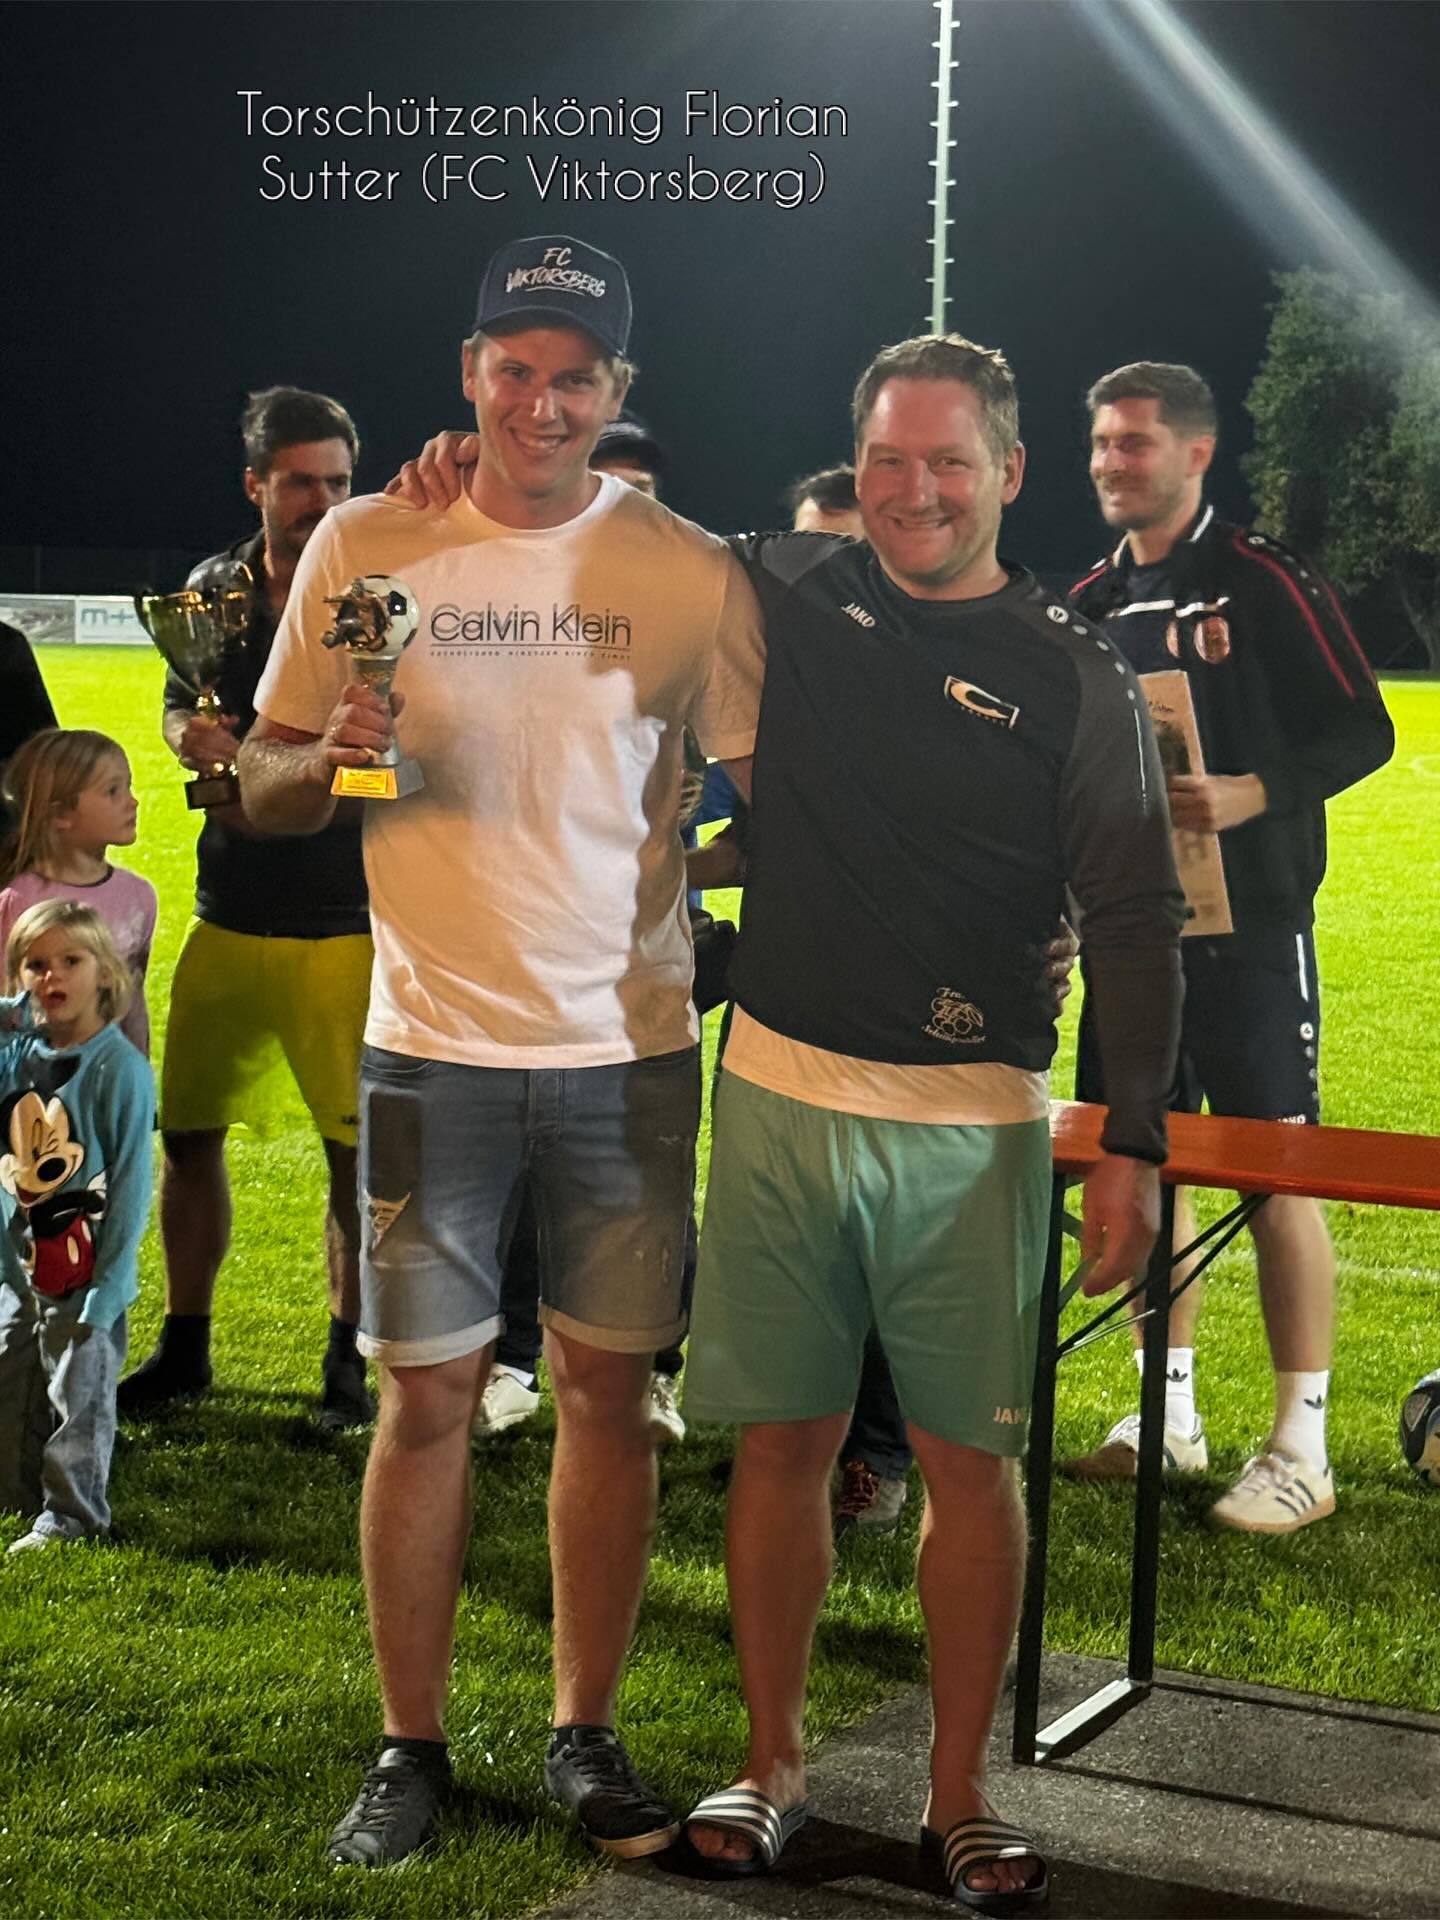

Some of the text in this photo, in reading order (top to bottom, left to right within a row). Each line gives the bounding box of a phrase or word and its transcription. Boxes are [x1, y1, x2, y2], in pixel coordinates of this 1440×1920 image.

[543, 247, 573, 266] FC
[506, 266, 606, 298] VIKTORSBERG
[430, 602, 632, 646] Calvin Klein
[840, 602, 876, 628] JAKO
